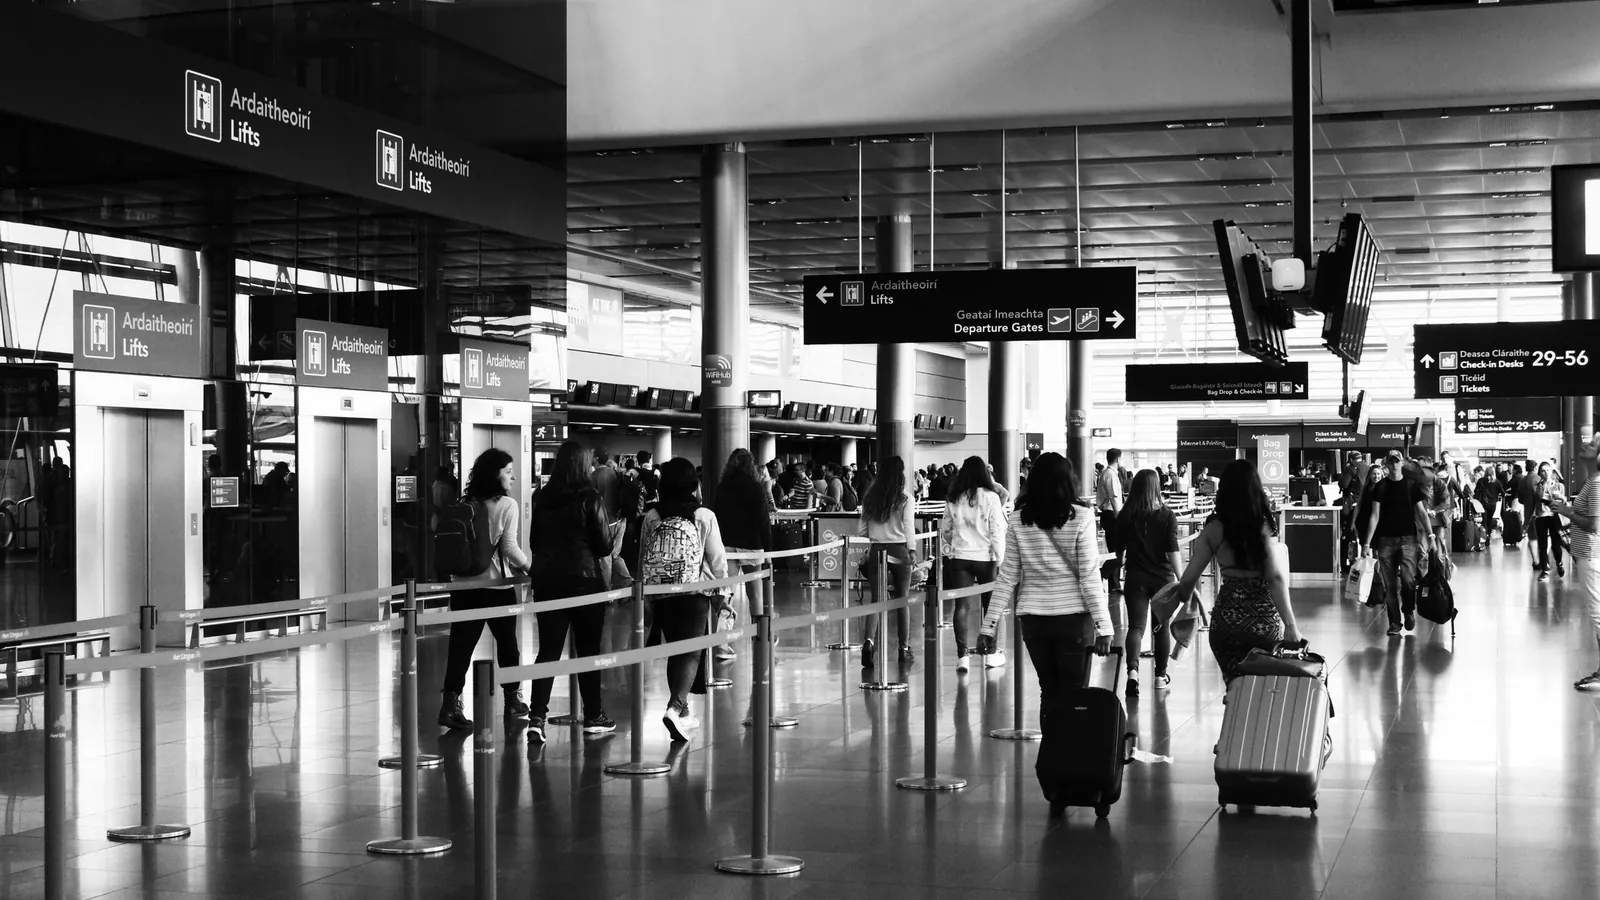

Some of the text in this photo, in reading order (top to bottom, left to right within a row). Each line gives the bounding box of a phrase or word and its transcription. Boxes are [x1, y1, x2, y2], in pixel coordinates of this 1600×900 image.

[230, 87, 311, 130] Ardaitheoirí
[231, 119, 260, 147] Lifts
[409, 143, 470, 177] Ardaitheoirí
[409, 170, 432, 194] Lifts
[871, 279, 938, 291] Ardaitheoirí
[870, 294, 894, 305] Lifts
[957, 309, 1044, 320] Geataí Imeachta
[122, 311, 193, 336] Ardaitheoirí
[954, 323, 1044, 335] Departure Gates
[123, 338, 149, 358] Lifts
[331, 335, 383, 356] Ardaitheoirí
[1460, 349, 1530, 358] Deasca Cláraithe
[1532, 350, 1589, 367] 29-56
[331, 358, 351, 375] Lifts
[486, 353, 526, 370] Ardaitheoirí
[1460, 360, 1524, 369] Check-in Desks
[486, 372, 501, 387] Lifts
[1460, 374, 1485, 382] Ticéid
[569, 382, 577, 393] 37
[591, 383, 600, 394] 38
[1460, 385, 1490, 393] Tickets
[1263, 440, 1281, 450] Bag
[1262, 450, 1285, 459] Drop
